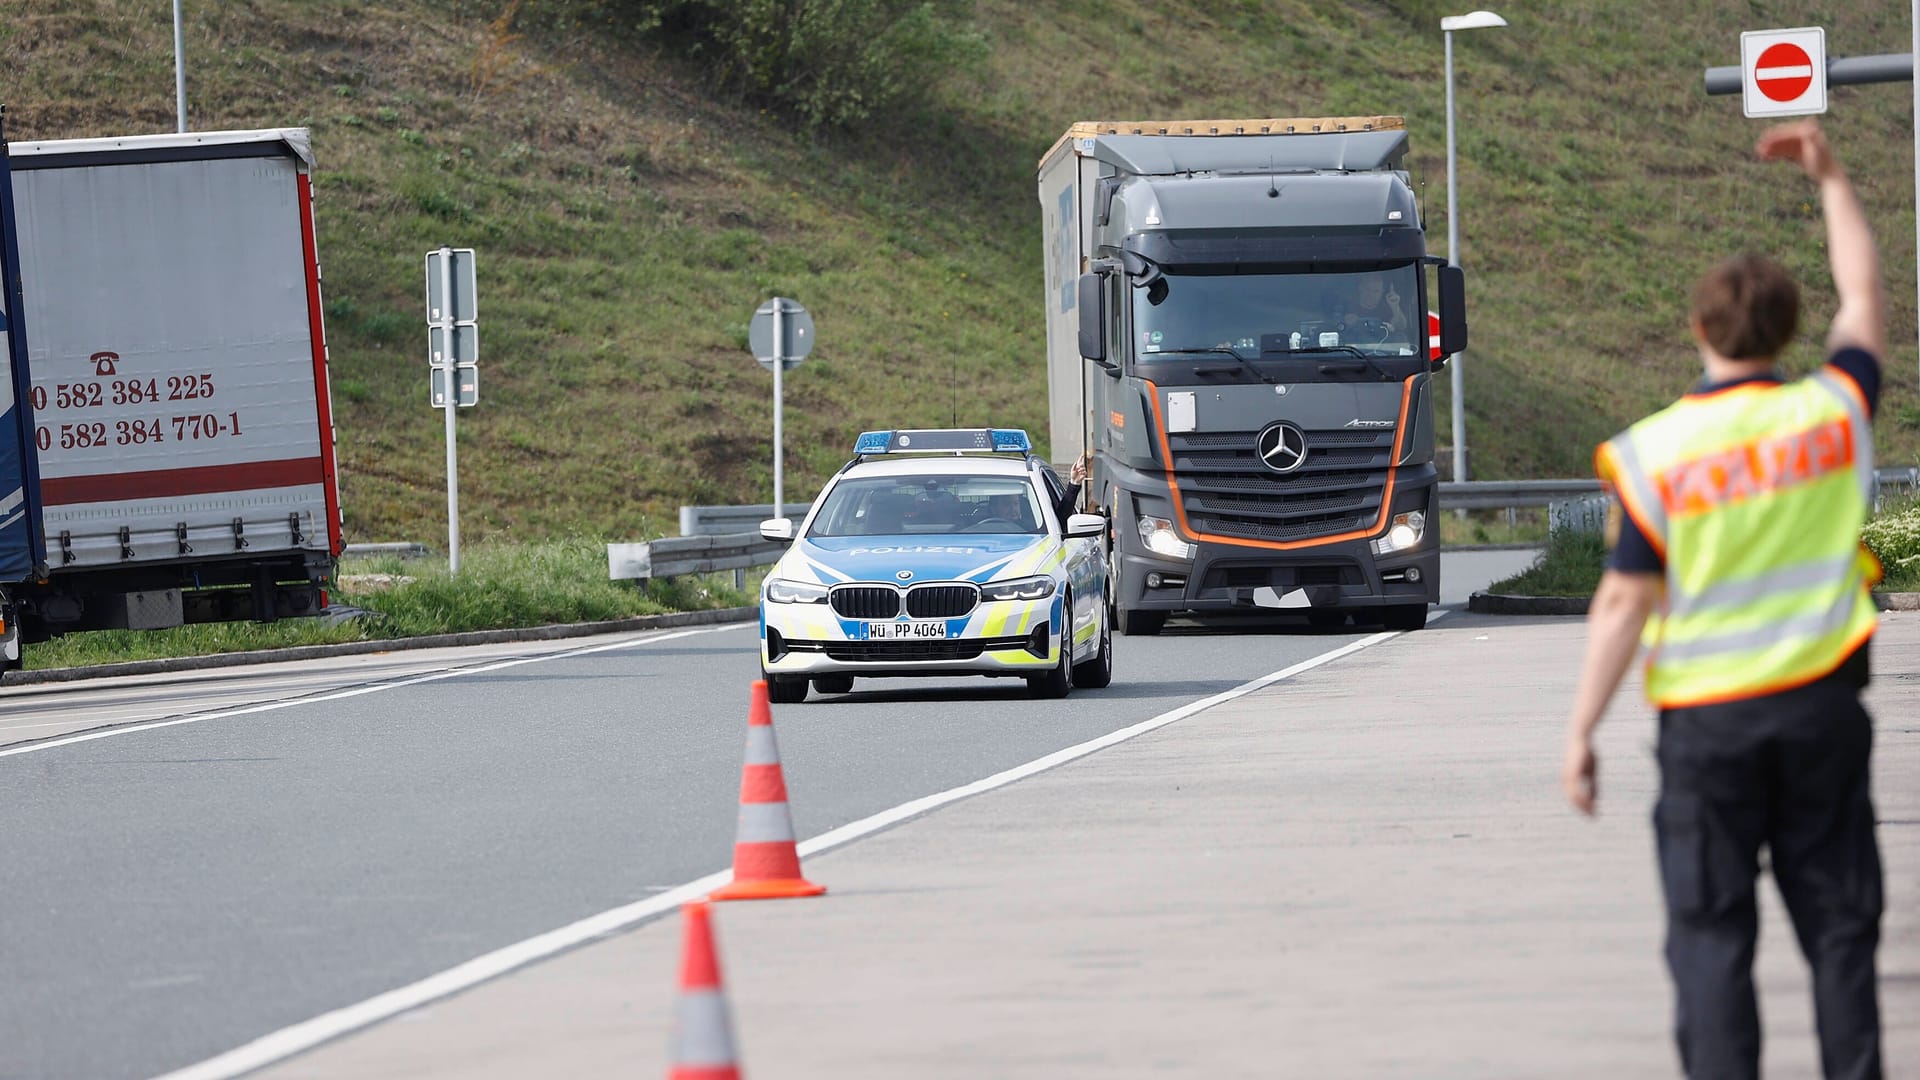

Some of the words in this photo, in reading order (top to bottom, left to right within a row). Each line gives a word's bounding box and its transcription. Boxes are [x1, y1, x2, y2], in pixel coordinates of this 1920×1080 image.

[56, 382, 103, 408] 582
[111, 378, 160, 405] 384
[167, 373, 215, 400] 225
[60, 422, 107, 449] 582
[116, 418, 164, 445] 384
[171, 411, 243, 441] 770-1
[1662, 423, 1847, 512] POLIZEI
[850, 547, 974, 556] POLIZEI
[894, 624, 911, 638] PP
[913, 623, 945, 637] 4064
